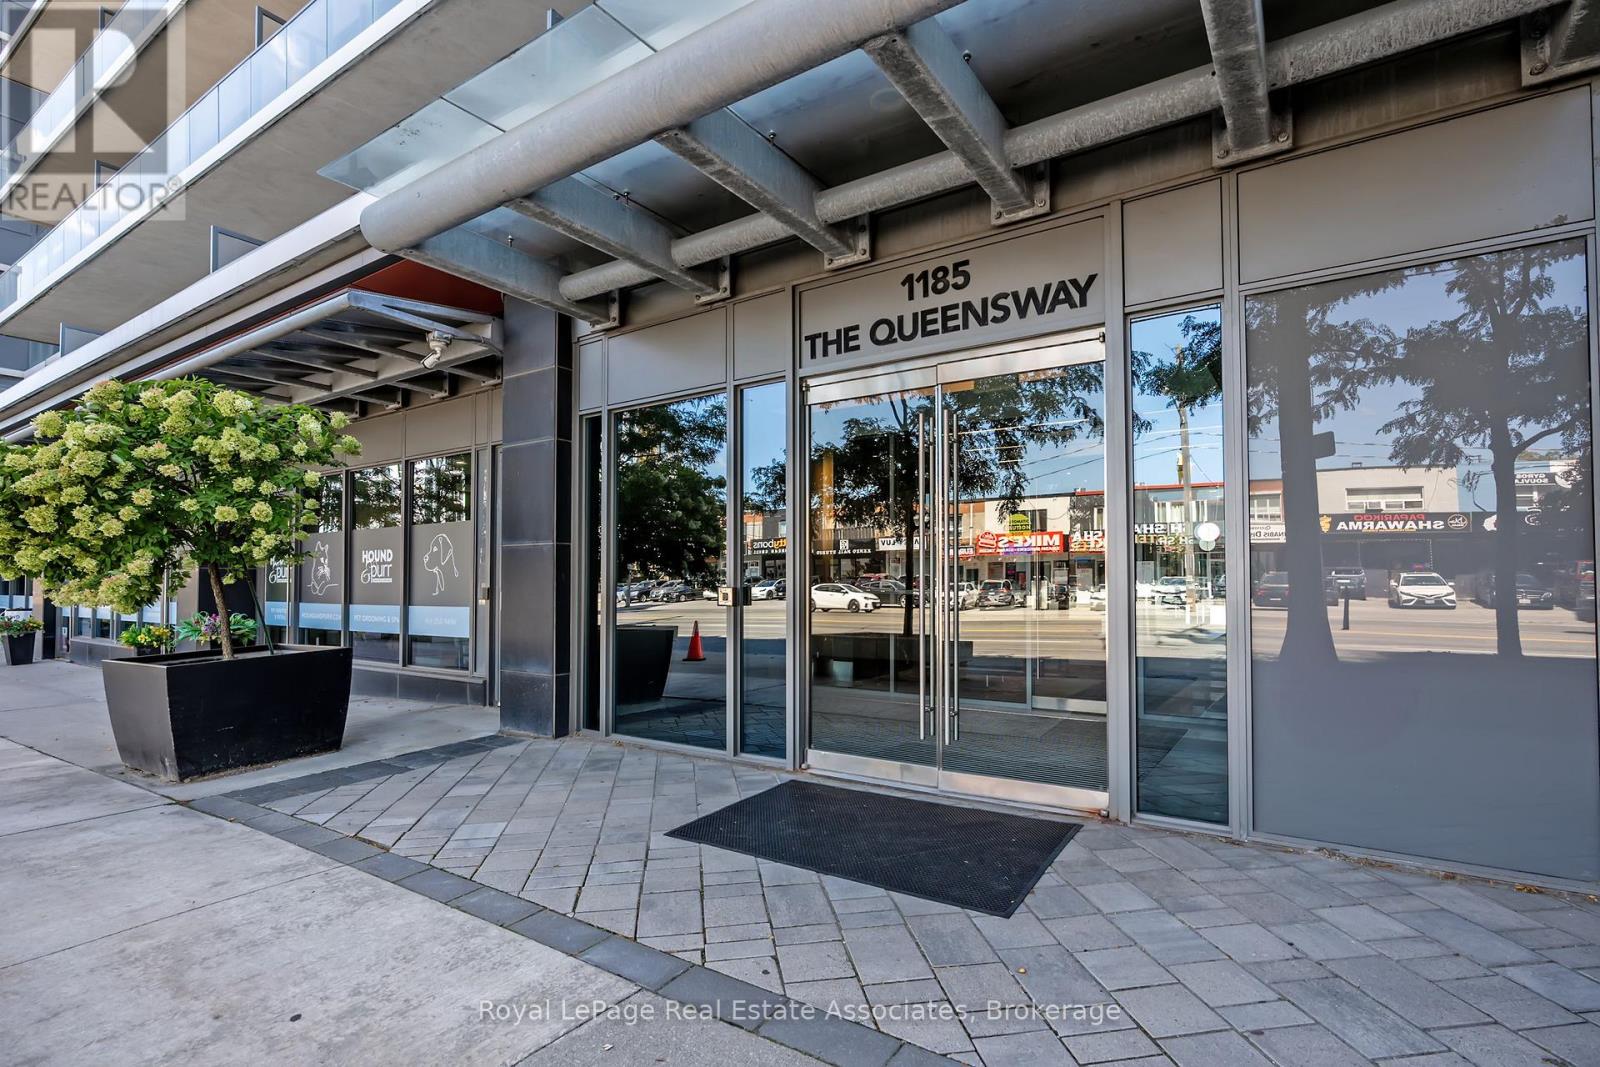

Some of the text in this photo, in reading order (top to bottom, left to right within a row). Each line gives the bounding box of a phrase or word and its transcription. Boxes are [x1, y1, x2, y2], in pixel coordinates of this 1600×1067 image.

[900, 259, 972, 301] 1185
[803, 273, 1099, 360] THE QUEENSWAY
[361, 549, 393, 564] HOUND
